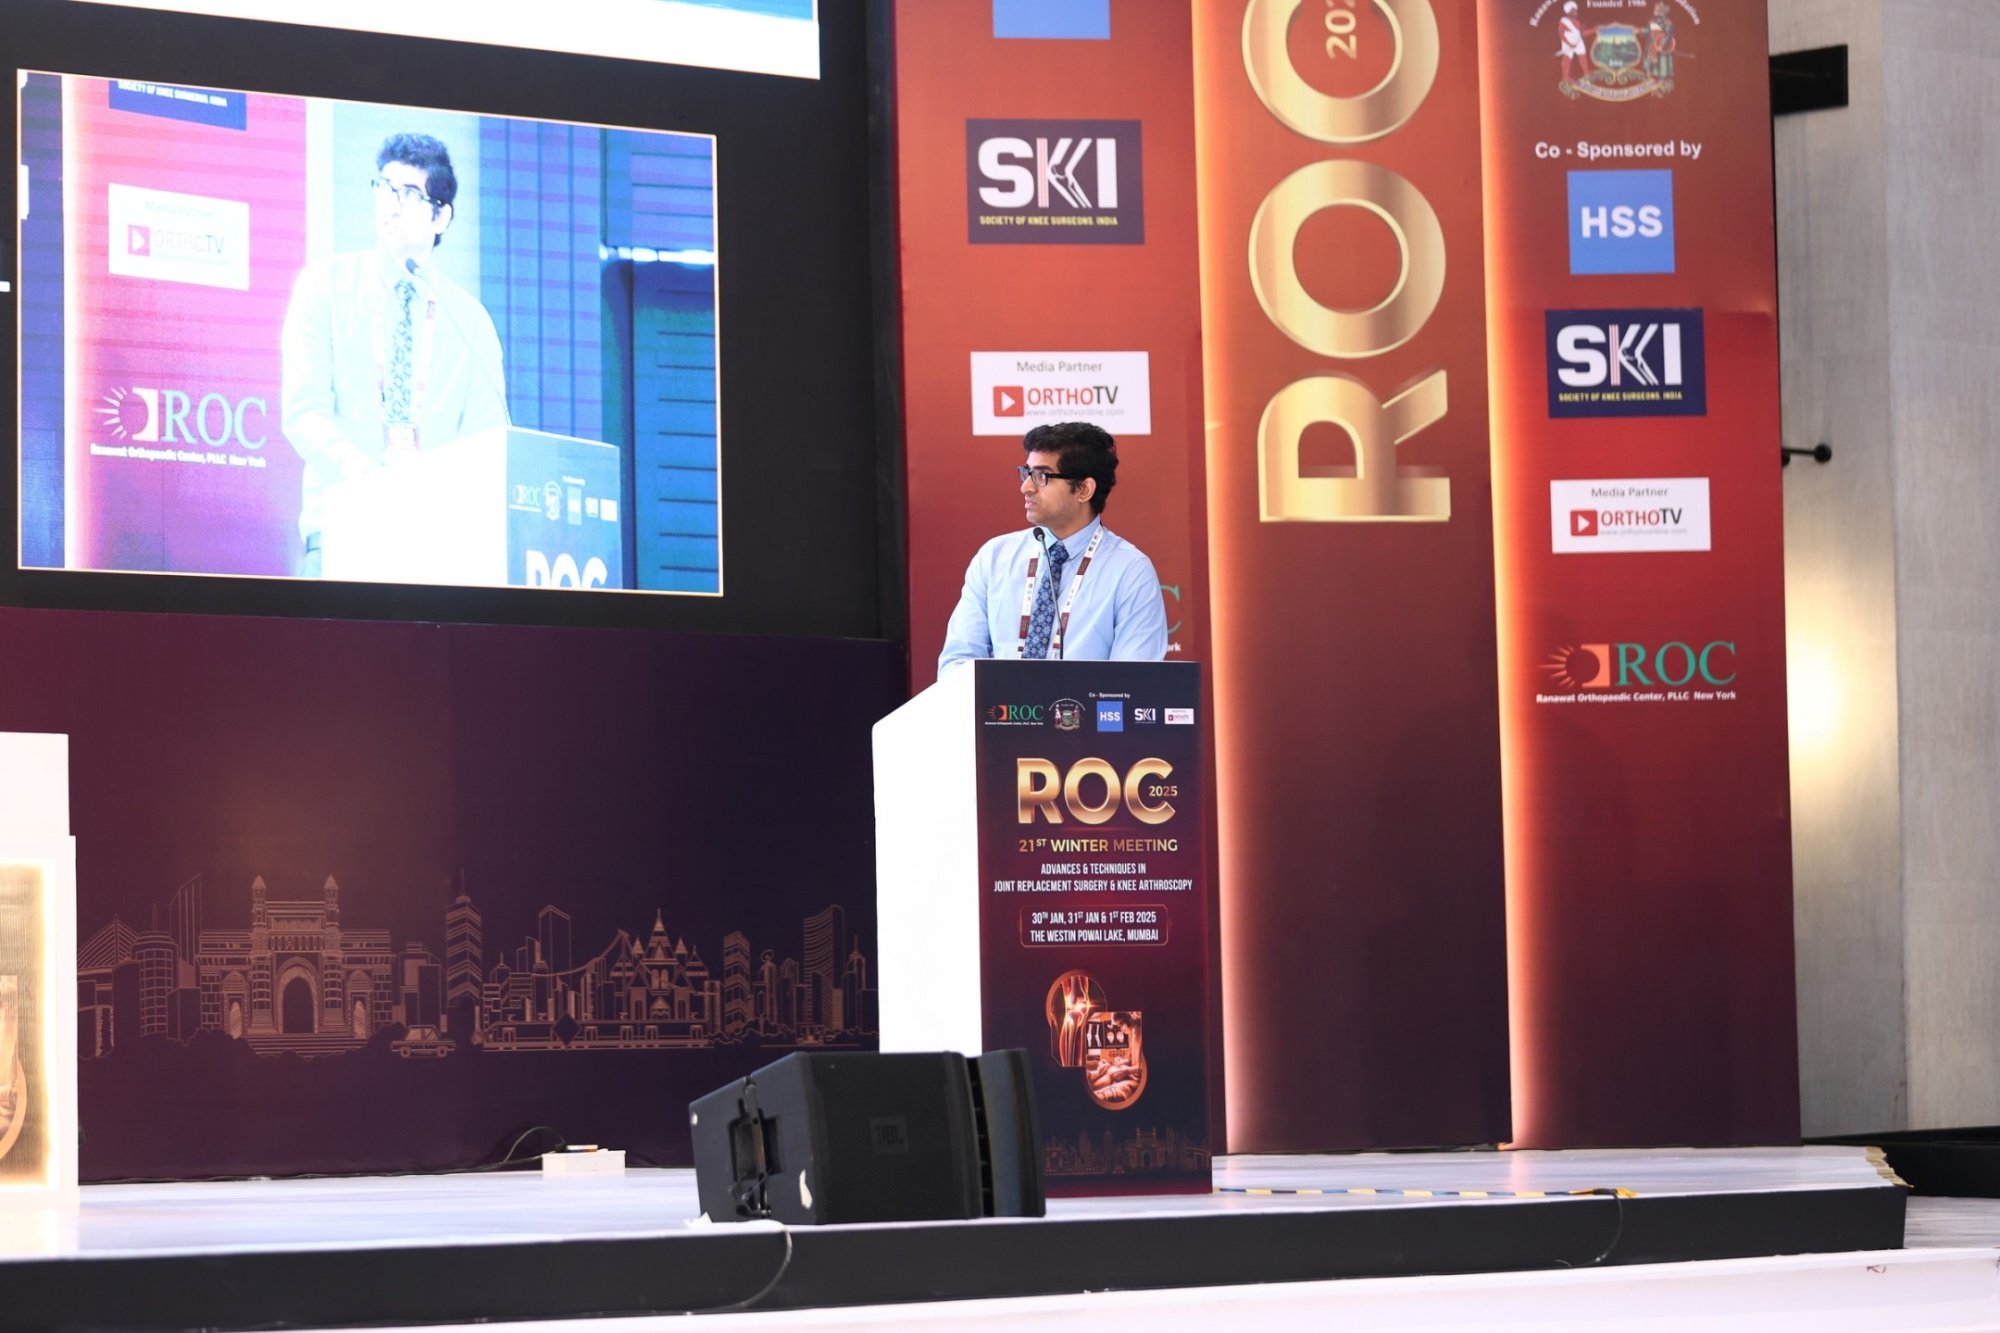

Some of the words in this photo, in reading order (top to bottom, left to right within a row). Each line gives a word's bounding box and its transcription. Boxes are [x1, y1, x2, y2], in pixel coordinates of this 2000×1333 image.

[1535, 141, 1560, 158] Co
[1577, 140, 1675, 161] Sponsored
[1680, 140, 1701, 160] by
[978, 137, 1118, 208] SKI
[980, 215, 1014, 225] SOCIETY
[1015, 215, 1026, 225] OF
[1028, 215, 1049, 225] KNEE
[1096, 215, 1118, 225] INDIA
[1581, 205, 1663, 238] HSS
[1556, 323, 1682, 386] SKI
[1017, 361, 1055, 372] Media
[1058, 361, 1102, 372] Partner
[1027, 386, 1118, 405] ORTHOTV
[1558, 392, 1589, 402] SOCIETY
[1590, 392, 1600, 402] OF
[1601, 391, 1620, 401] KNEE
[1663, 390, 1682, 400] INDIA
[160, 389, 267, 449] ROC
[1591, 487, 1625, 497] Media
[1628, 487, 1668, 497] Partner
[1601, 508, 1682, 526] ORTHOTV
[1167, 642, 1181, 652] ork
[1614, 640, 1736, 686] ROC
[1536, 692, 1575, 703] Ranawat
[1577, 692, 1631, 703] Orthopaedic
[1633, 691, 1665, 703] Center,
[1667, 691, 1689, 700] PLLC
[1693, 691, 1713, 700] New
[1716, 690, 1736, 700] York
[1008, 704, 1044, 720] ROC
[1100, 711, 1120, 721] HSS
[1134, 708, 1156, 721] SKI
[1017, 757, 1176, 825] ROC
[1149, 785, 1178, 797] 2025
[1018, 838, 1047, 852] 21ST
[1050, 839, 1108, 852] WINTER
[1113, 839, 1178, 852] MEETING
[1041, 863, 1081, 874] ADVANCES
[1083, 863, 1088, 874] &
[1090, 863, 1136, 874] TECHNIQUES
[1138, 863, 1146, 874] IN
[994, 880, 1015, 892] JOINT
[1017, 880, 1071, 892] REPLACEMENT
[1074, 880, 1108, 891] SURGERY
[1110, 880, 1115, 891] &
[1117, 879, 1137, 891] KNEE
[1138, 879, 1192, 890] ARTHROSCOPY
[1031, 911, 1048, 924] 30TH
[1050, 911, 1066, 925] JAN,
[1068, 911, 1083, 924] 31ST
[1085, 911, 1099, 924] JAN
[1101, 911, 1106, 923] &
[1120, 911, 1134, 923] FEB
[1136, 911, 1156, 923] 2025
[1030, 930, 1045, 942] THE
[1046, 929, 1076, 942] WESTIN
[1078, 929, 1102, 941] POWAI
[1103, 929, 1125, 942] LAKE,
[1127, 929, 1159, 941] MUMBAI
